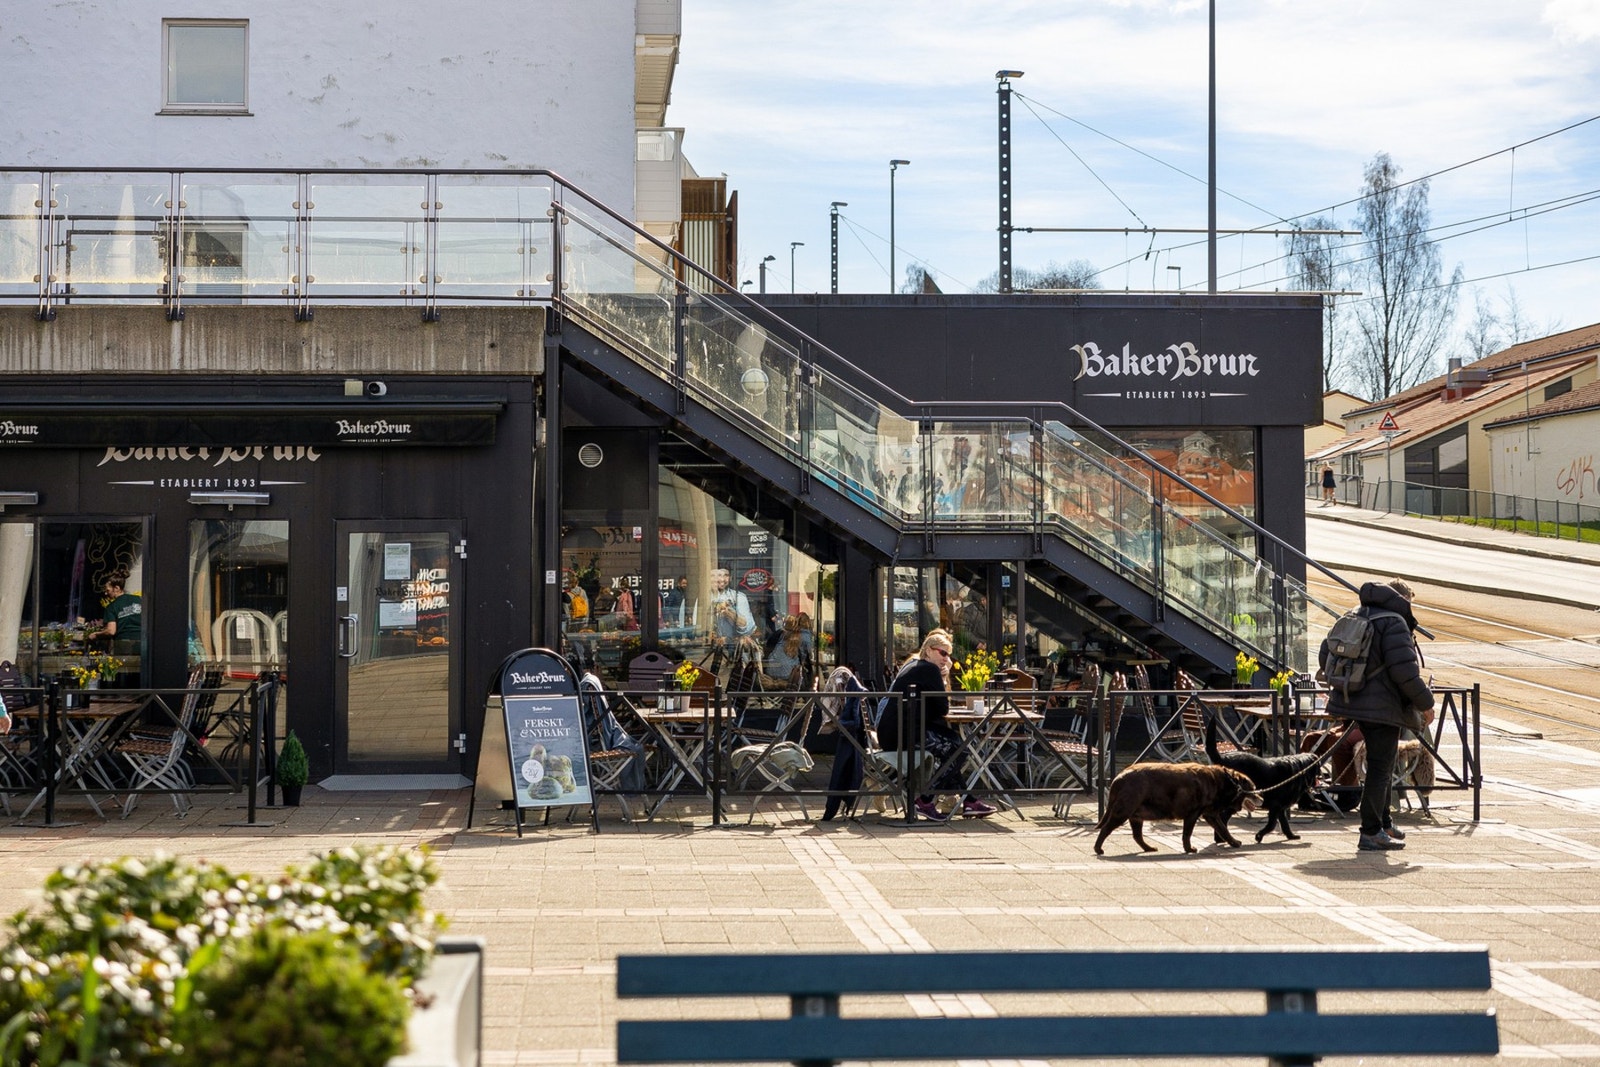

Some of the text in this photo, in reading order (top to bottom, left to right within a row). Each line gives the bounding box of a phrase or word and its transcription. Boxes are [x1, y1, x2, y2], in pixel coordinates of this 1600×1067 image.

[1069, 341, 1260, 382] BakerBrun
[1126, 391, 1206, 399] ETABLERT 1893
[335, 419, 412, 436] BakerBrun
[160, 478, 256, 488] ETABLERT 1893
[510, 671, 566, 685] BakerBrun
[524, 718, 564, 728] FERSKT
